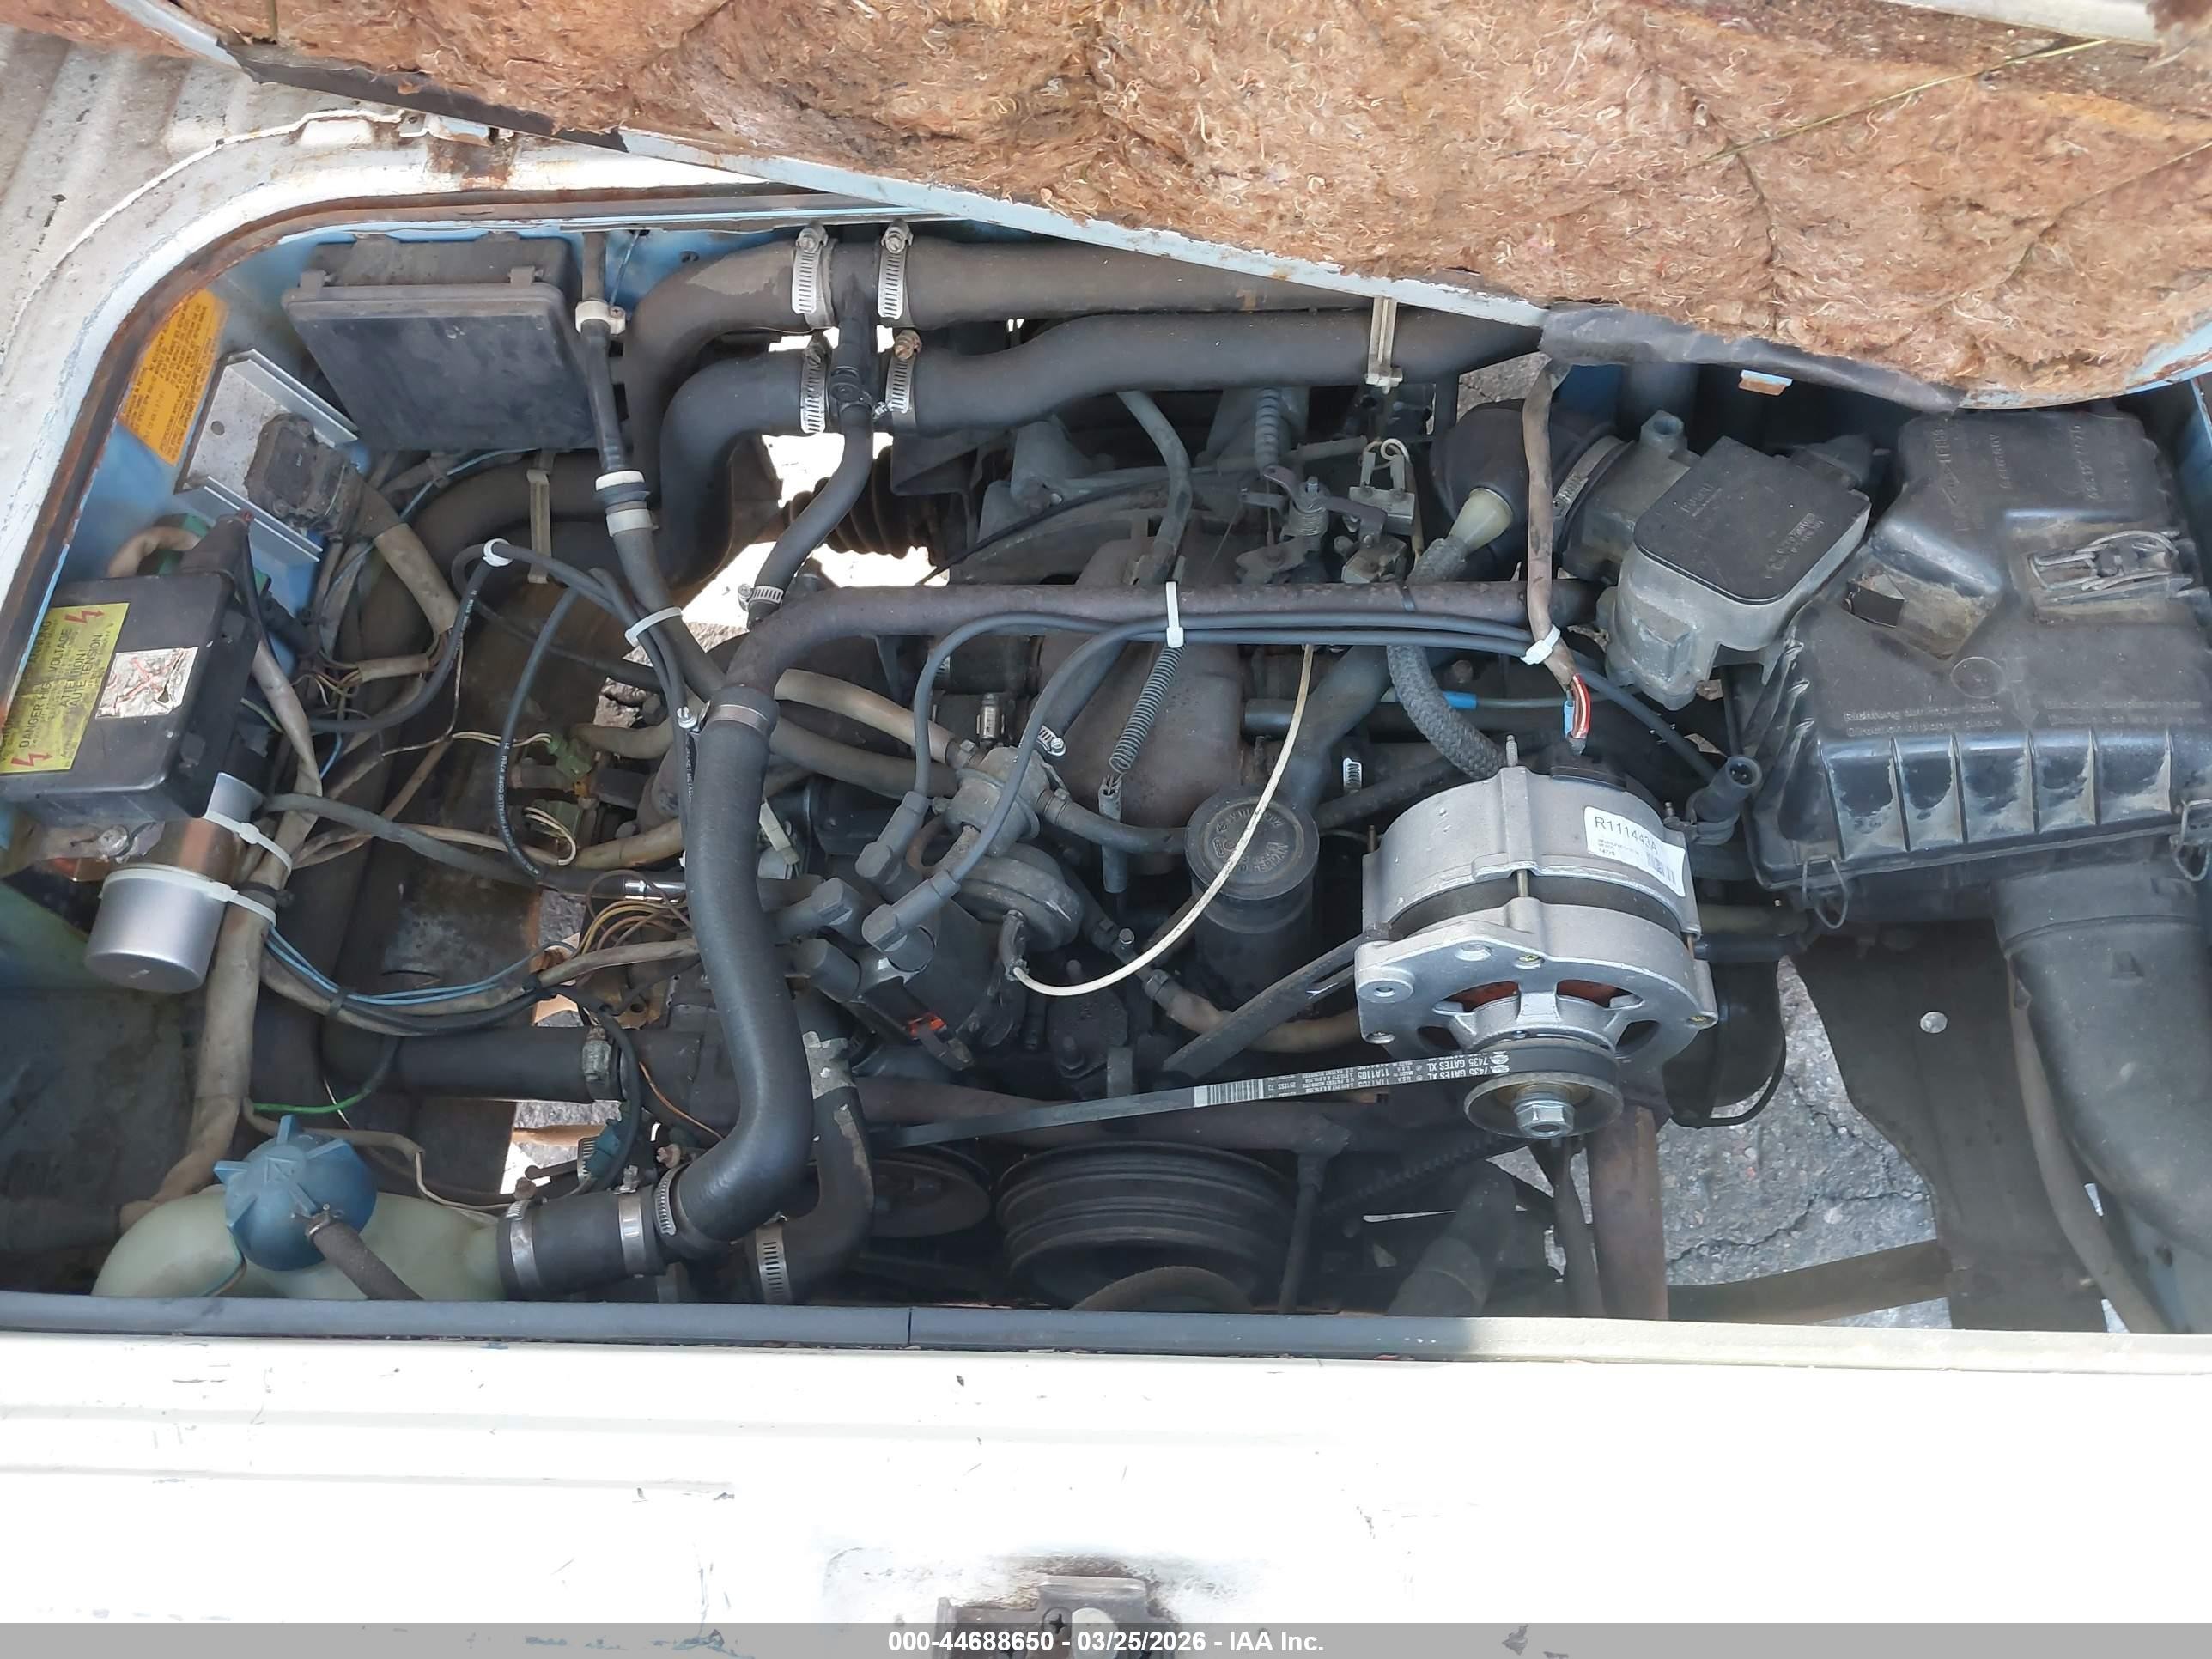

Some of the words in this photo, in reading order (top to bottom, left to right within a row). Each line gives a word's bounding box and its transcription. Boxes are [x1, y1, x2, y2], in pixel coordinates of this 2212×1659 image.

[19, 703, 43, 748] DANGER
[48, 627, 72, 673] VOLTAGE
[1426, 1062, 1437, 1072] XL
[1438, 1058, 1465, 1070] GATES
[1468, 1055, 1489, 1067] 7435
[1357, 1067, 1389, 1079] 11A1105
